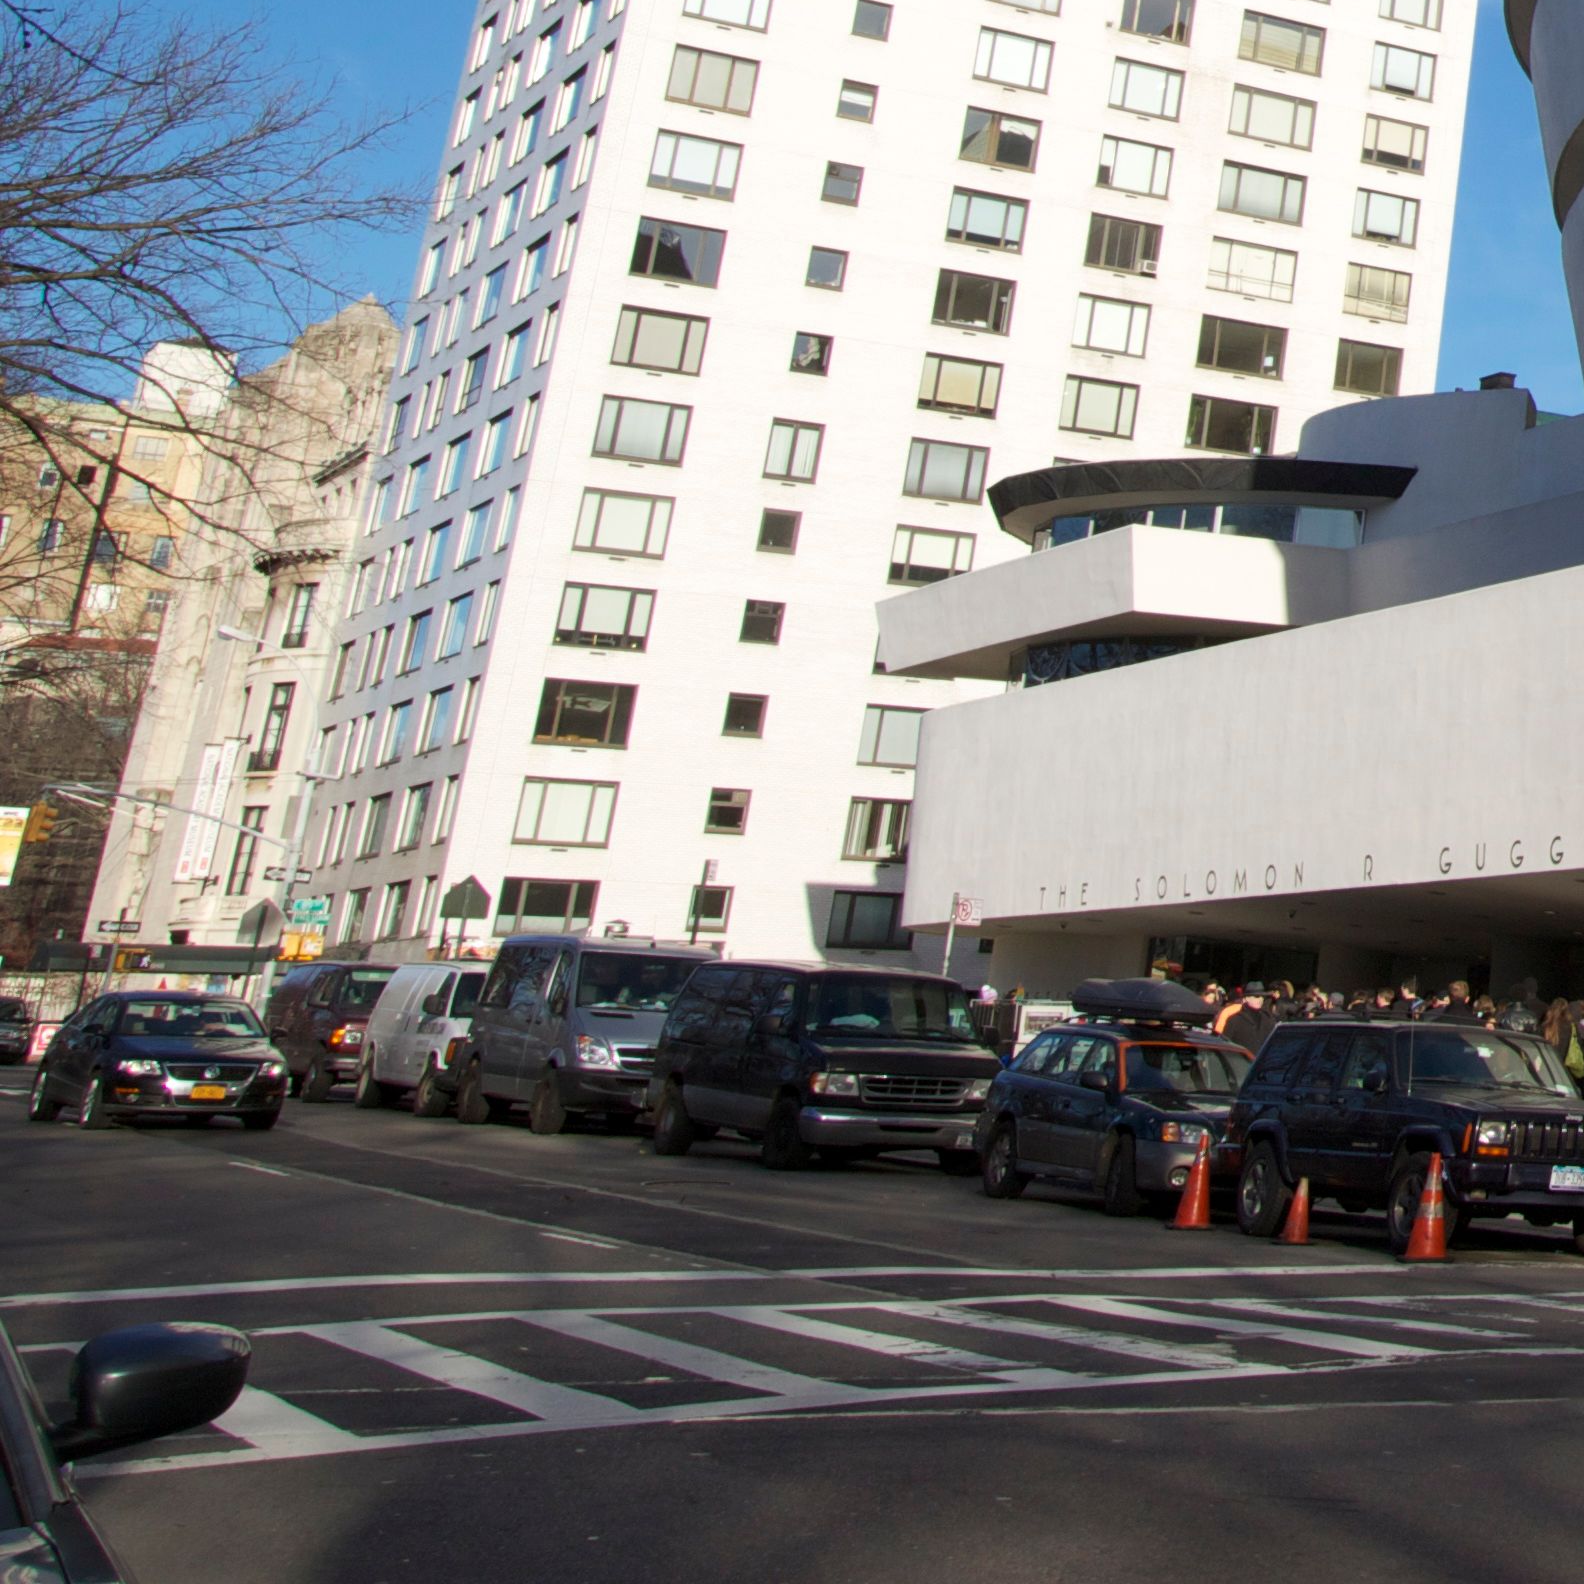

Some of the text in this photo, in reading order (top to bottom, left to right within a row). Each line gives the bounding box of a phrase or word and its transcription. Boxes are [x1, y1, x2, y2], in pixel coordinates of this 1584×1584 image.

[1040, 882, 1088, 910] THE
[1133, 861, 1305, 901] SOLOMON
[1363, 854, 1374, 882] R
